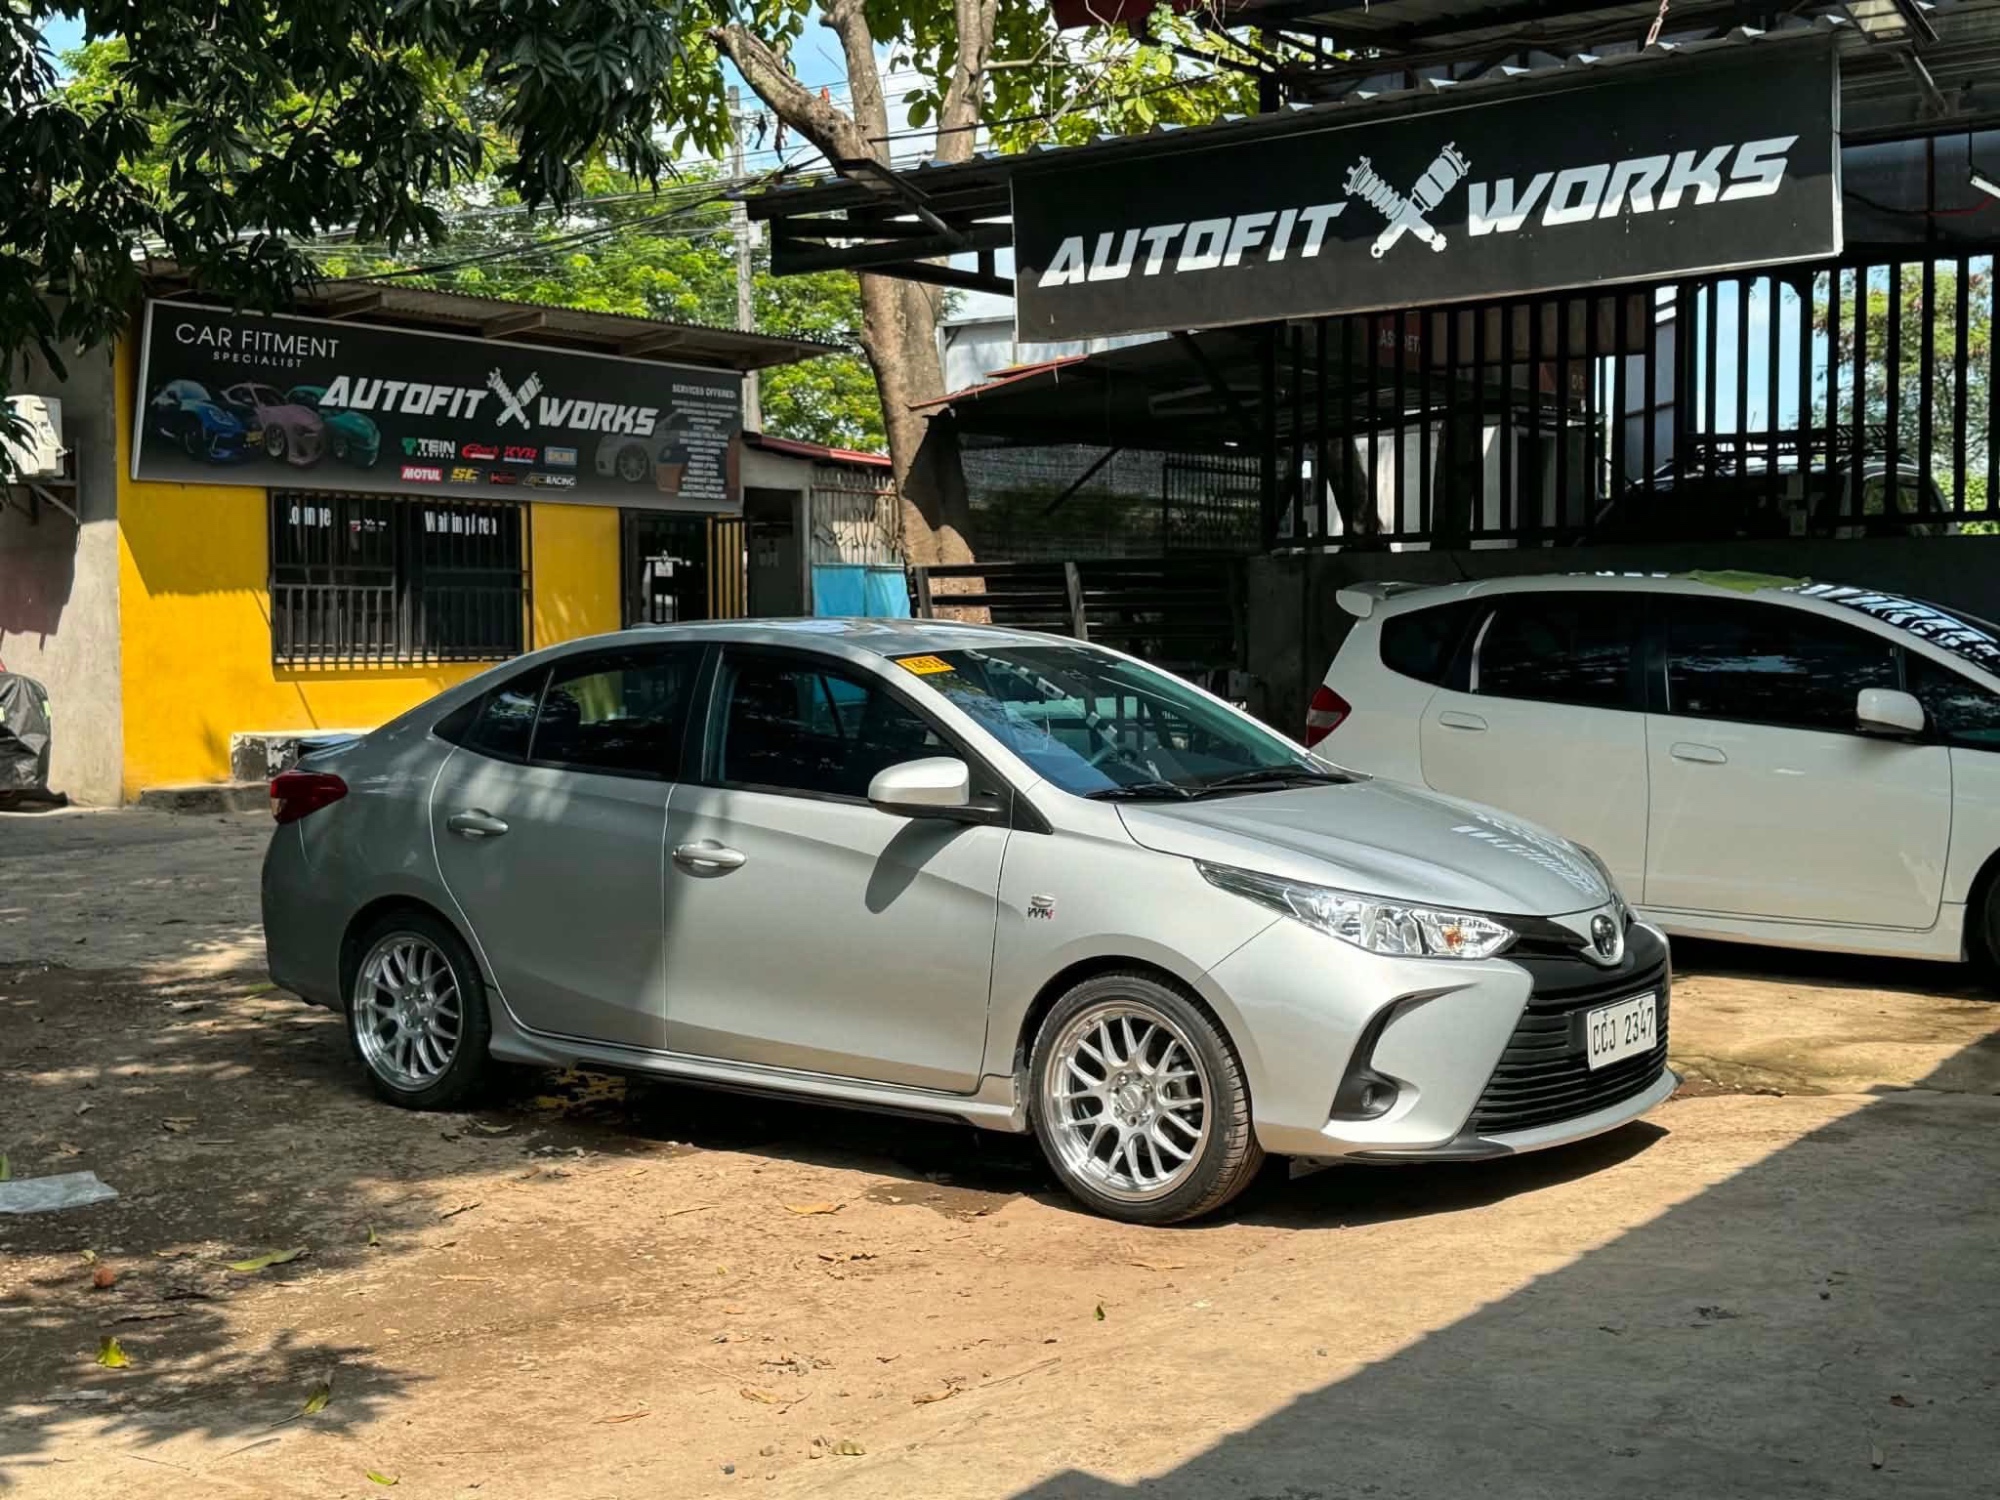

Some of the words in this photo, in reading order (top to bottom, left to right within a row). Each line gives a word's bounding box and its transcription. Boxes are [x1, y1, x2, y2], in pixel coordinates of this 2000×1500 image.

[1038, 201, 1347, 287] AUTOFIT
[1466, 134, 1799, 237] WORKS
[175, 323, 232, 348] CAR
[241, 330, 340, 359] FITMENT
[213, 351, 302, 368] SPECIALIST
[318, 375, 489, 419] AUTOFIT
[538, 396, 660, 436] WORKS
[417, 438, 456, 454] TEIN
[402, 468, 441, 482] MOTUL
[1593, 1019, 1616, 1056] CCJ
[1624, 1006, 1654, 1046] 2347
